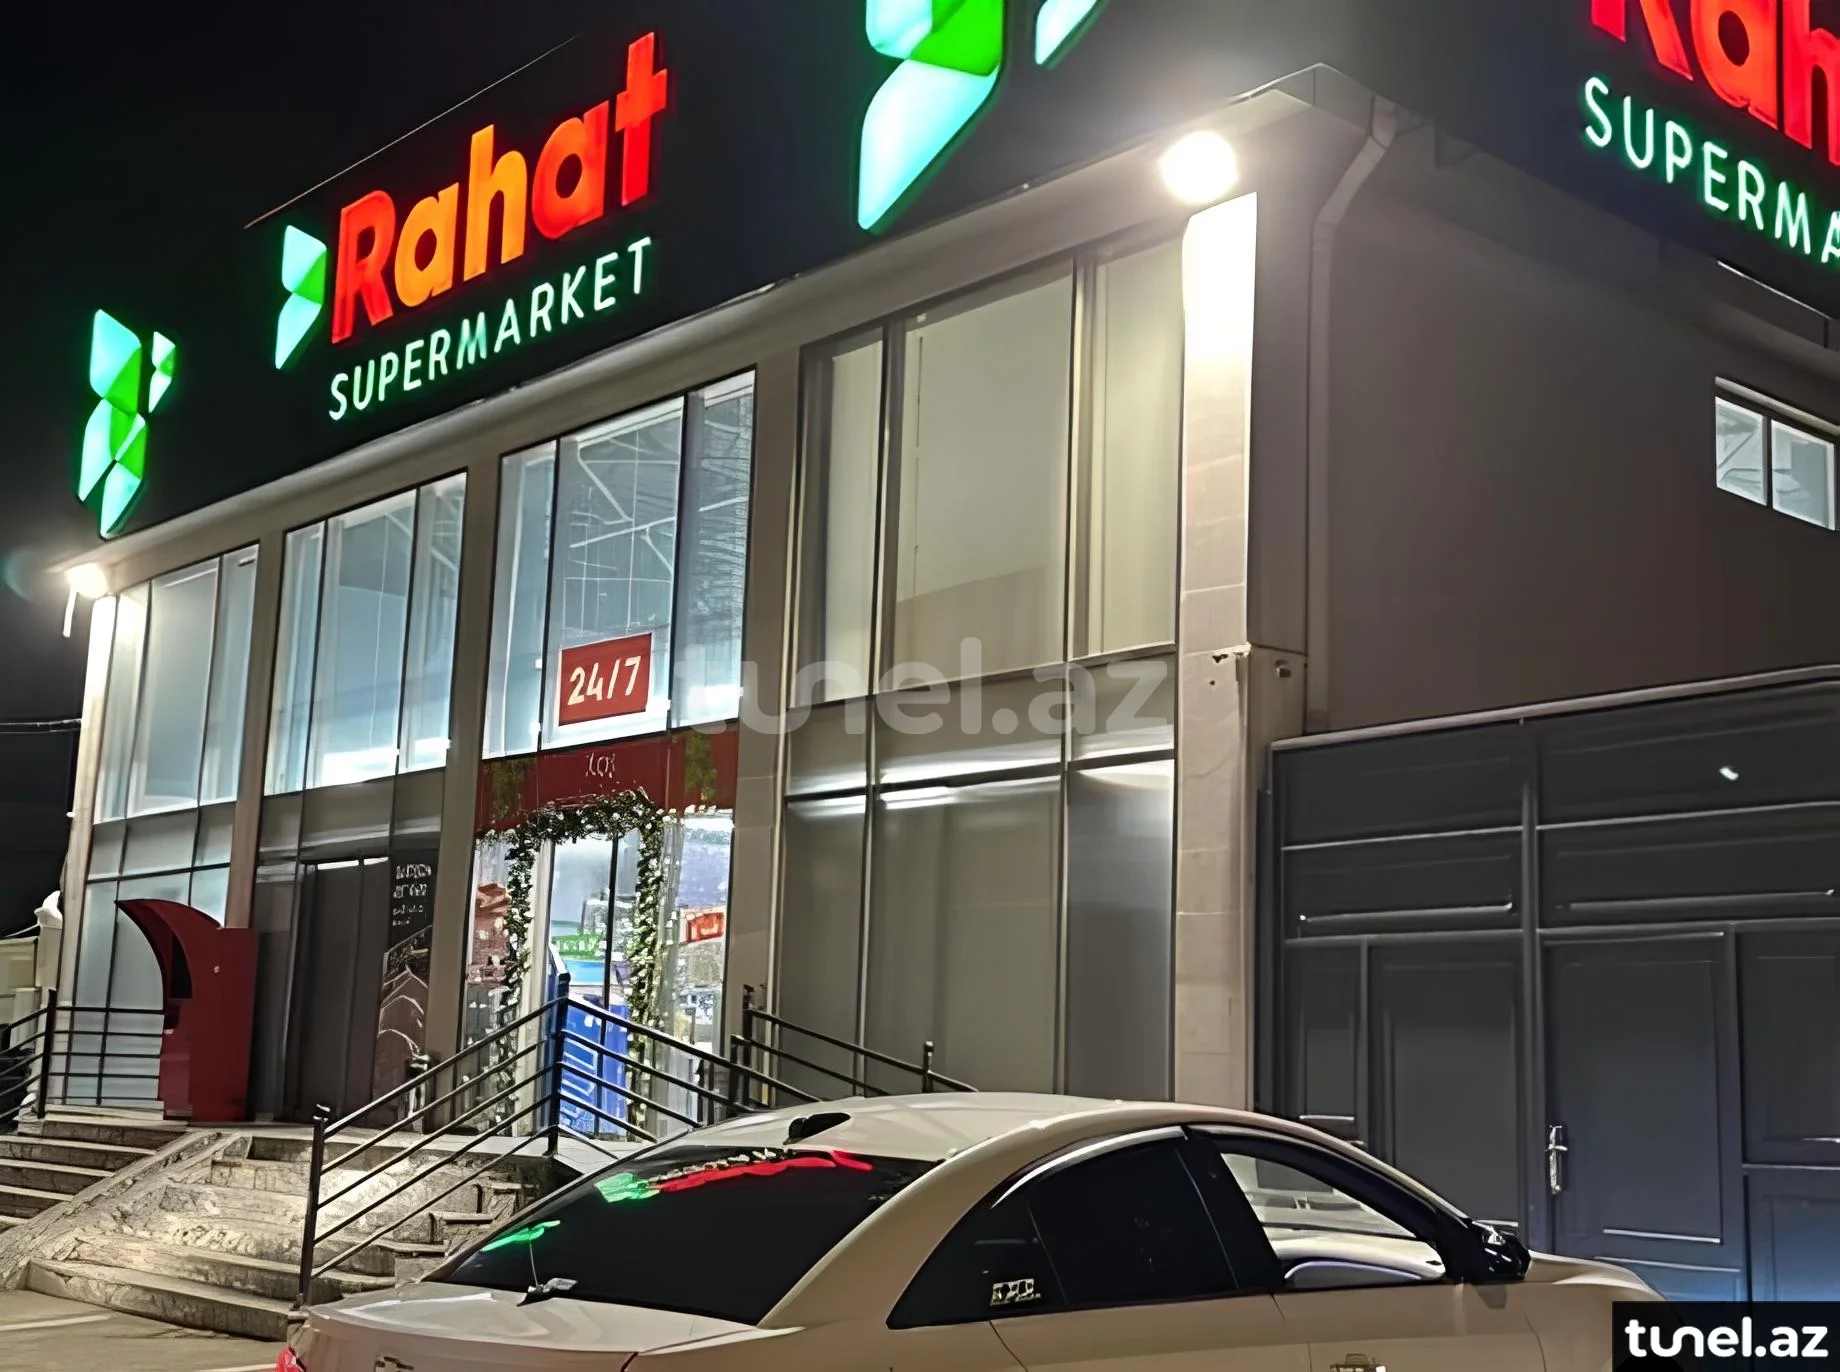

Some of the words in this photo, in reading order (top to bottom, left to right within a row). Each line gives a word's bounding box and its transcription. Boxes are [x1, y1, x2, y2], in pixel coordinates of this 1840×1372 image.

[332, 32, 668, 344] Rahat
[328, 236, 652, 421] SUPERMARKET
[567, 655, 642, 706] 24/7
